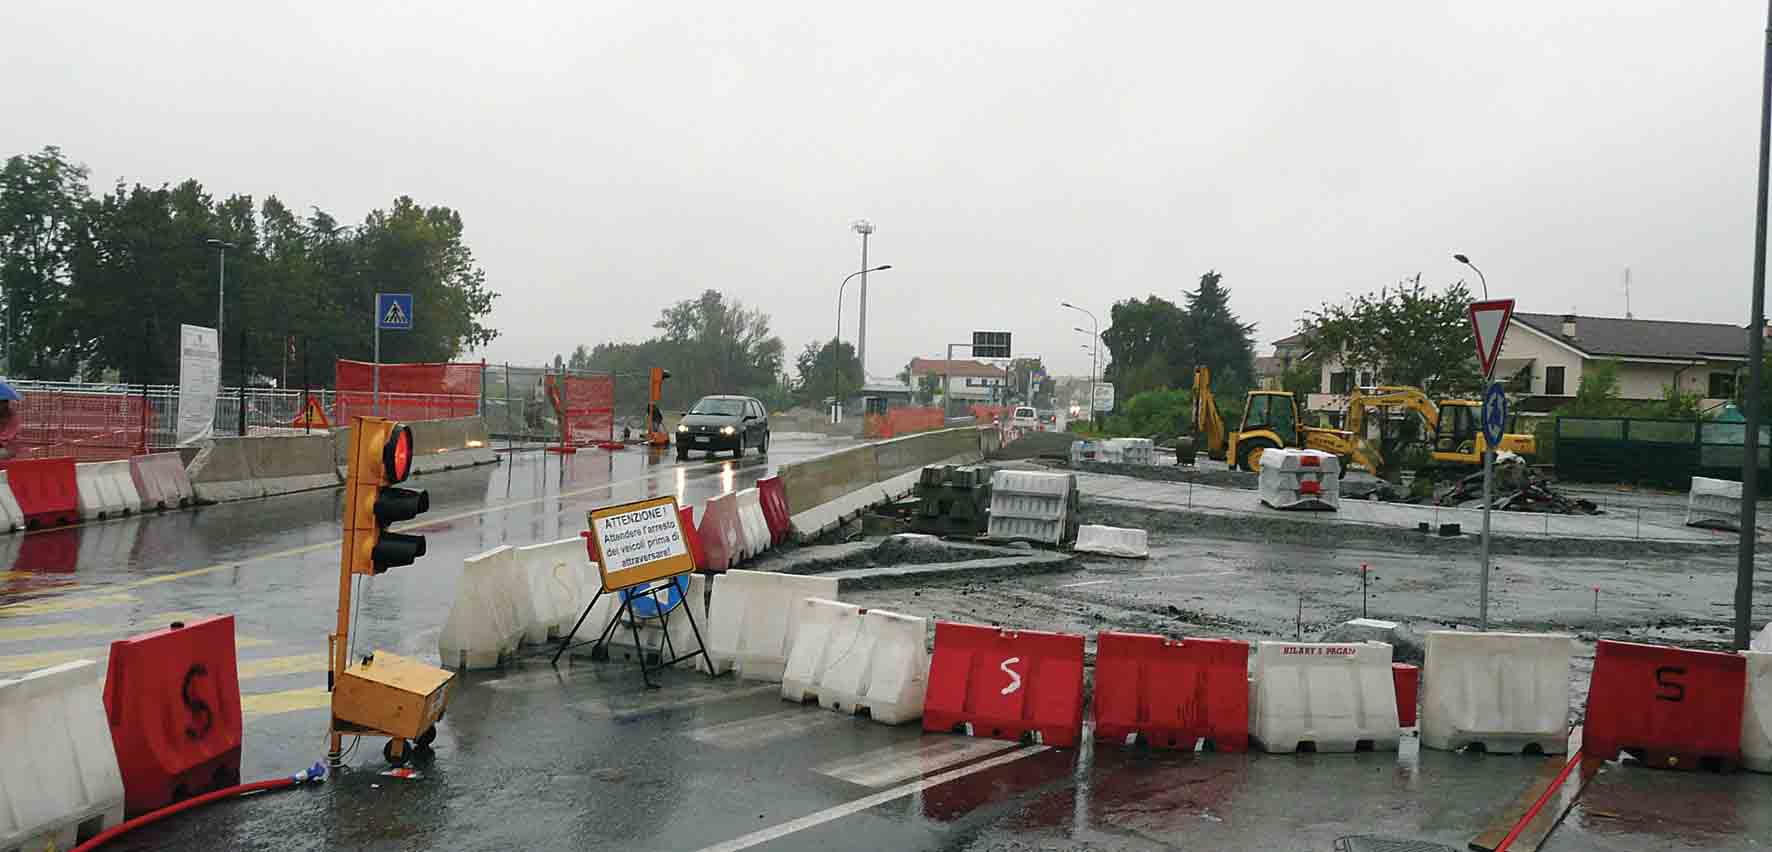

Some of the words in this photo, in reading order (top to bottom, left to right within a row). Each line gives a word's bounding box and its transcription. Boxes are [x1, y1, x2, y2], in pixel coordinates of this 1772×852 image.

[647, 535, 670, 549] prima
[1000, 656, 1021, 696] S
[181, 663, 214, 738] S
